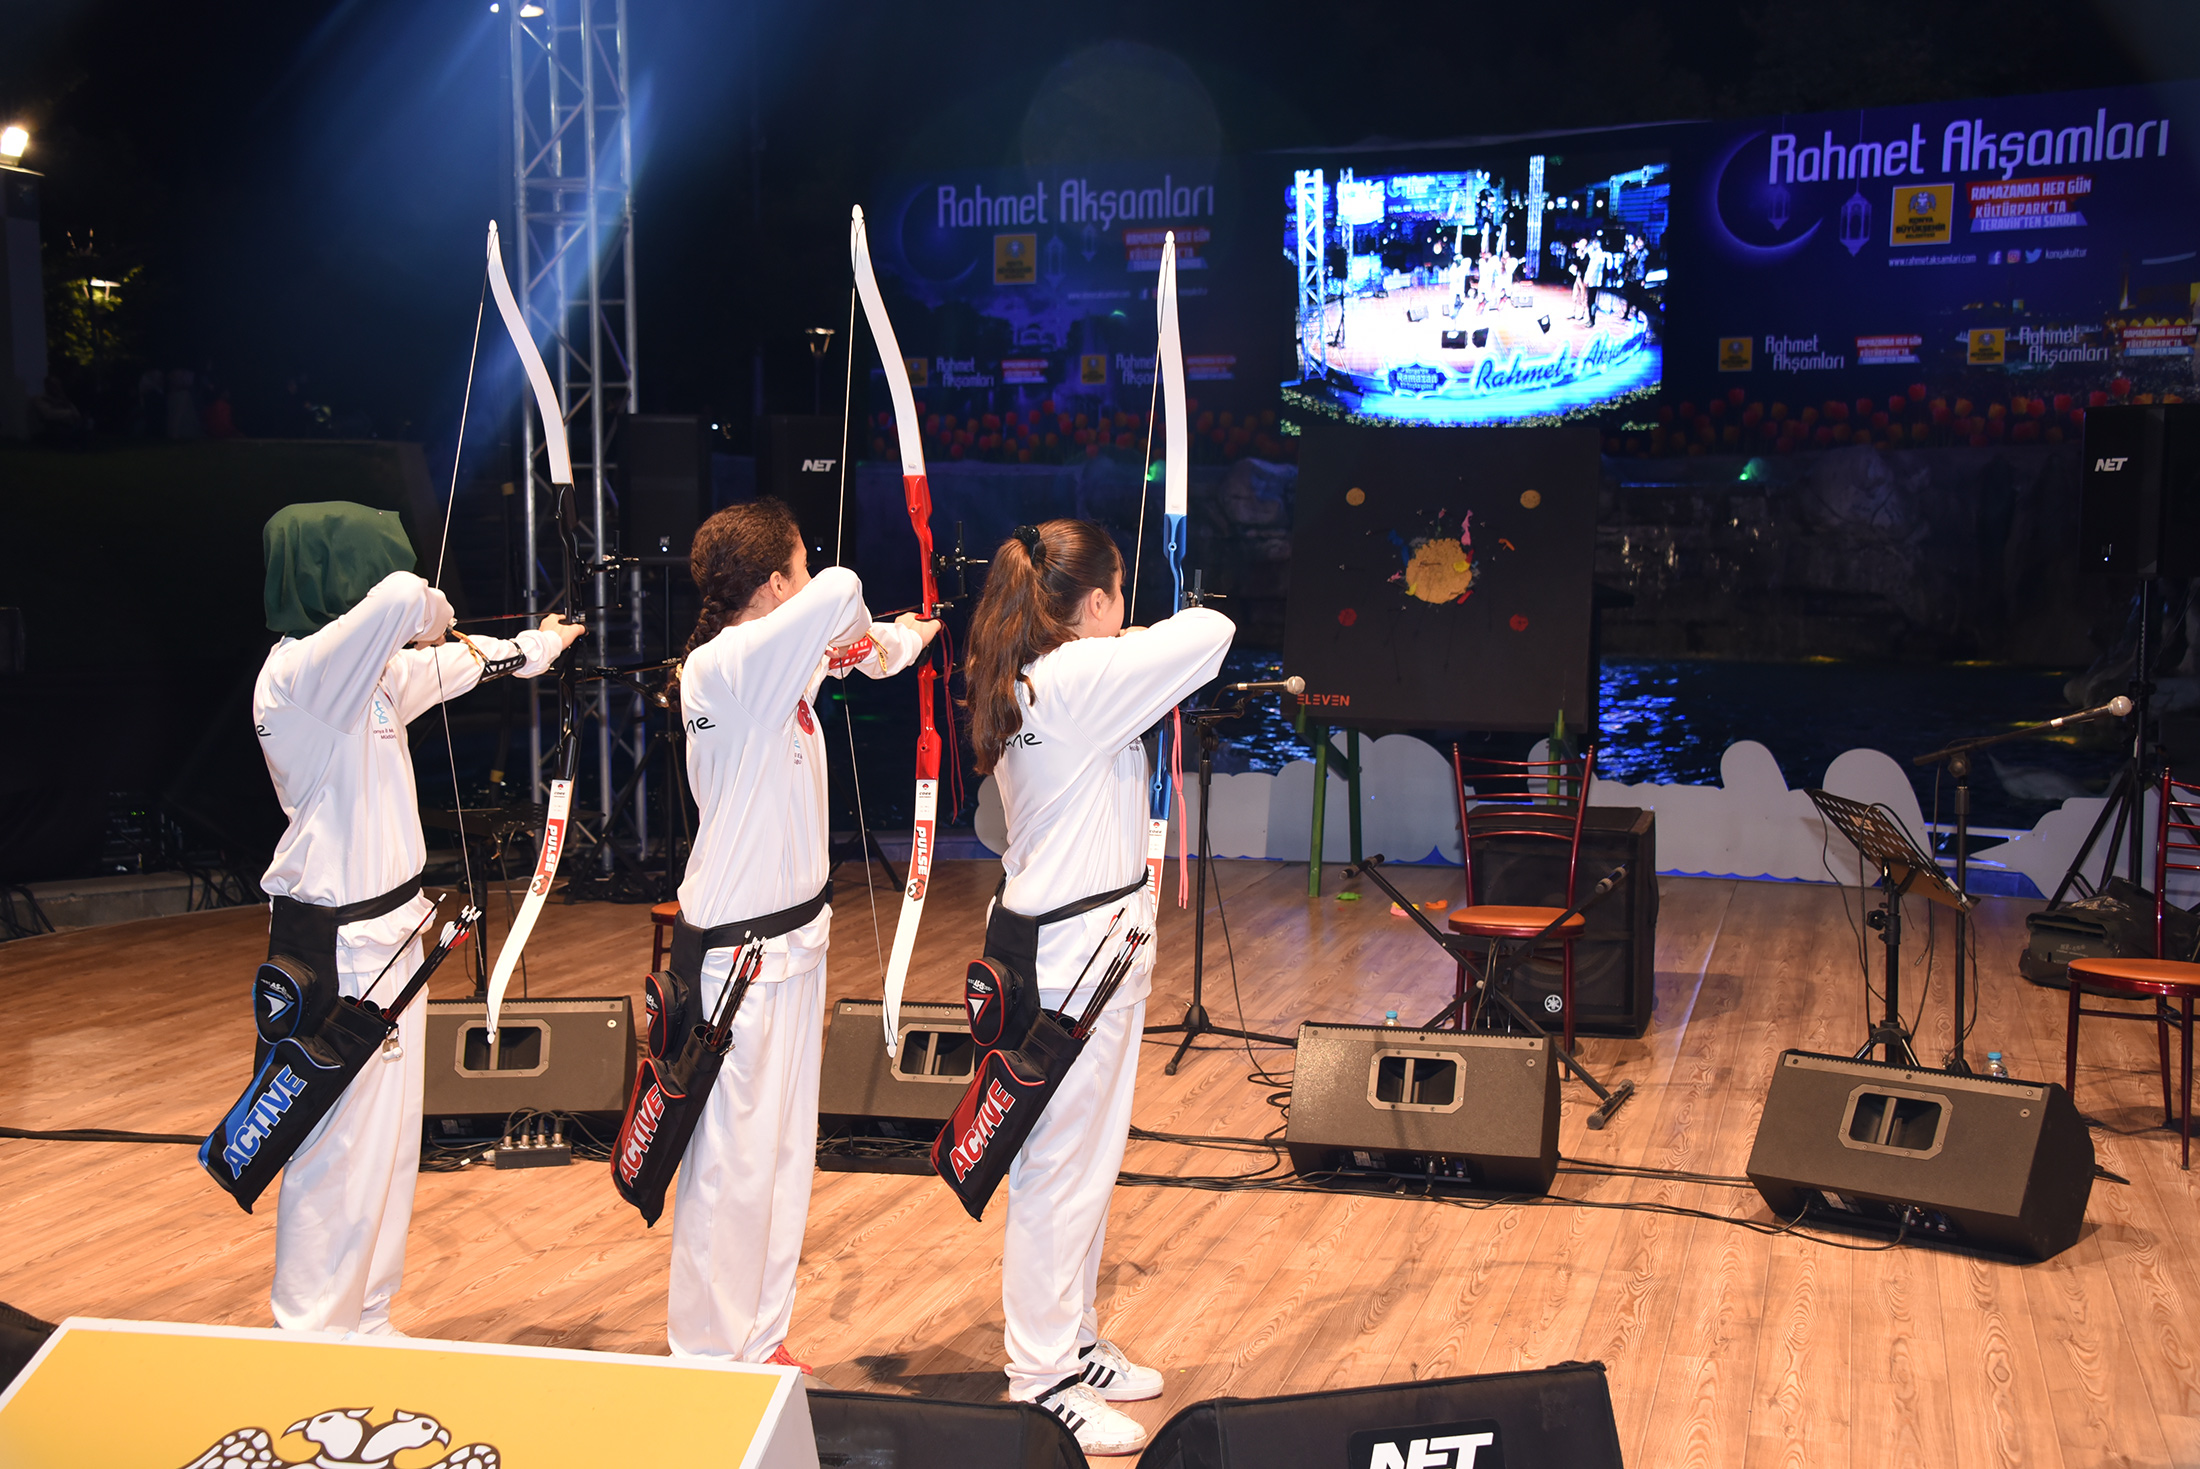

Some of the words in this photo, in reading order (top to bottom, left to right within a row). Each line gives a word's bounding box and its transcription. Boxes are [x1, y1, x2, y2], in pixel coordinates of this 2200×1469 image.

[1768, 122, 1927, 185] Rahmet
[1941, 107, 2170, 181] Akşamları
[937, 180, 1049, 229] Rahmet
[1059, 174, 1214, 232] Akşamları
[1970, 182, 2041, 201] RAMAZANDA
[2042, 180, 2066, 197] HER
[2067, 176, 2092, 195] GÜN
[2043, 213, 2077, 227] SONRA
[1764, 332, 1820, 354] Rahmet
[2019, 324, 2080, 346] Rahmet
[1475, 348, 1568, 390] Rahmet
[1772, 350, 1845, 374] Akşamları
[2028, 343, 2110, 369] Akşamları
[801, 459, 837, 473] NET
[2094, 457, 2129, 472] NET
[1296, 693, 1351, 707] ELEVEN
[544, 824, 559, 873] PULSE
[915, 826, 929, 876] PULSE
[222, 1064, 308, 1181] ACTIVE
[619, 1082, 667, 1189] ACTIVE
[947, 1077, 1018, 1184] ACTIVE
[1369, 1431, 1494, 1469] NET
